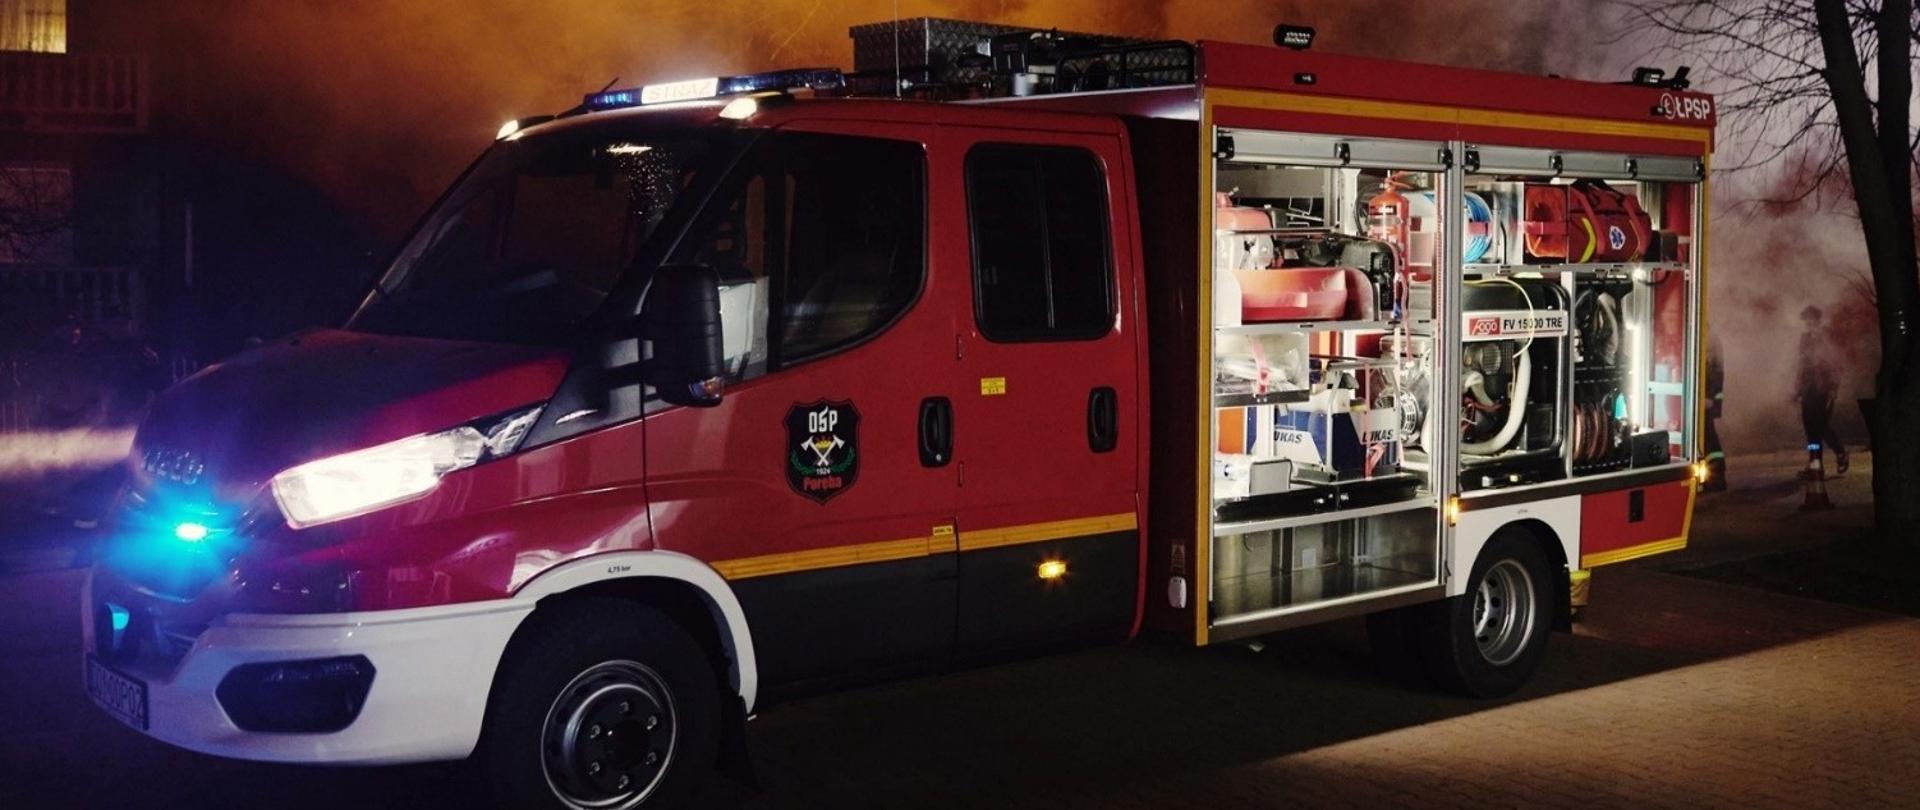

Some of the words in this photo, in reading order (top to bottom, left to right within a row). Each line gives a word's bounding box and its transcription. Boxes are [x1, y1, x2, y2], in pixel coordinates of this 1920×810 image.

[1676, 97, 1711, 119] ŁPSP
[1503, 319, 1515, 330] FV
[1545, 317, 1562, 328] TRE
[808, 406, 838, 433] OSP
[1275, 431, 1302, 443] UKAS
